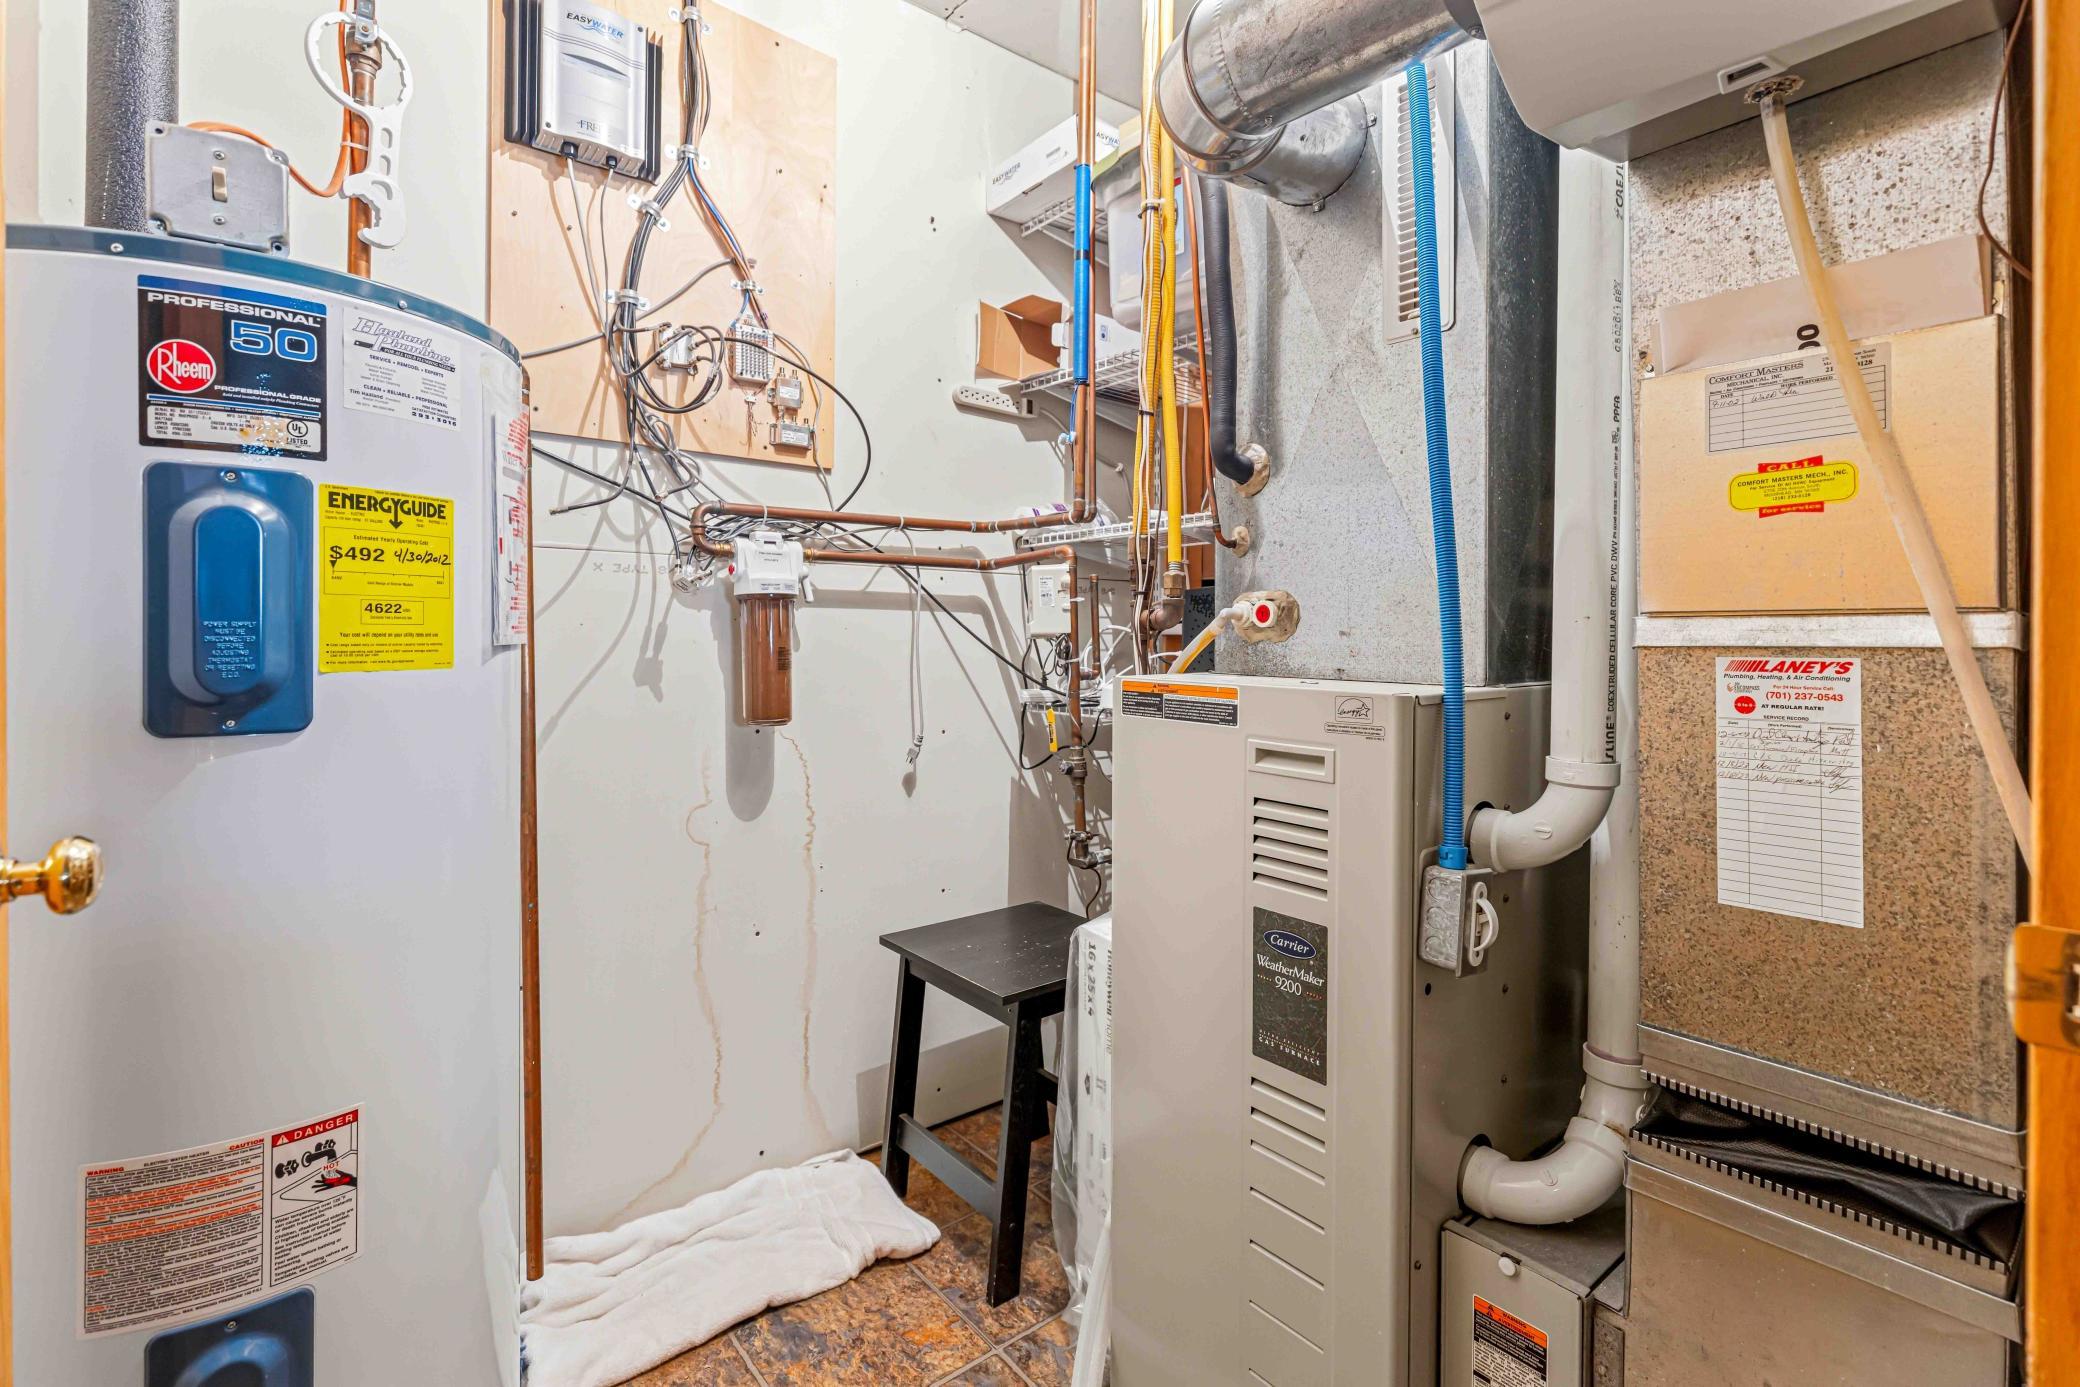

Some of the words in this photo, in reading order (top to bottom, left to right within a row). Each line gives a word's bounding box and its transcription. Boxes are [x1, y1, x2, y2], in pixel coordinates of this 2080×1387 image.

[1614, 163, 1624, 208] CRESL
[148, 292, 320, 327] PROFESSIONAL
[230, 320, 318, 362] 50
[158, 342, 211, 384] Rheem
[370, 355, 391, 364] SERVICE
[397, 361, 419, 371] REMODEL
[424, 369, 443, 378] EXPERTS
[1709, 373, 1754, 385] COMFORT
[1756, 362, 1804, 376] MASTERS
[1799, 375, 1833, 385] PERFORMED
[214, 385, 289, 399] PROFESSIONAL
[289, 394, 321, 403] GRADE
[363, 384, 381, 392] CLEAN
[387, 389, 410, 399] RELIABLE
[415, 396, 447, 408] PROFESSIONAL
[292, 422, 303, 435] UL
[1767, 460, 1814, 472] CALL
[1737, 479, 1769, 487] COMFORT
[1772, 475, 1803, 483] MASTERS
[328, 491, 446, 522] ENERGYGUIDE
[381, 536, 395, 544] Yearly
[330, 545, 384, 562] $492
[613, 563, 648, 574] TYPE
[1609, 584, 1617, 608] CORE
[365, 603, 402, 613] 4622
[1757, 660, 1854, 675] LANEY'S
[1608, 654, 1616, 712] COEXTRUDED
[1766, 692, 1791, 701] (701)
[1795, 693, 1844, 701] 237-0543
[1270, 934, 1309, 954] Carrier
[1256, 954, 1325, 987] WeatherMaker
[1087, 975, 1096, 992] 25
[1274, 976, 1302, 995] 9200
[1280, 1046, 1321, 1066] FURNACE
[294, 1114, 353, 1140] DANGER
[229, 1138, 264, 1150] CAUTION
[87, 1167, 124, 1176] WARNING
[323, 1161, 340, 1171] HOT
